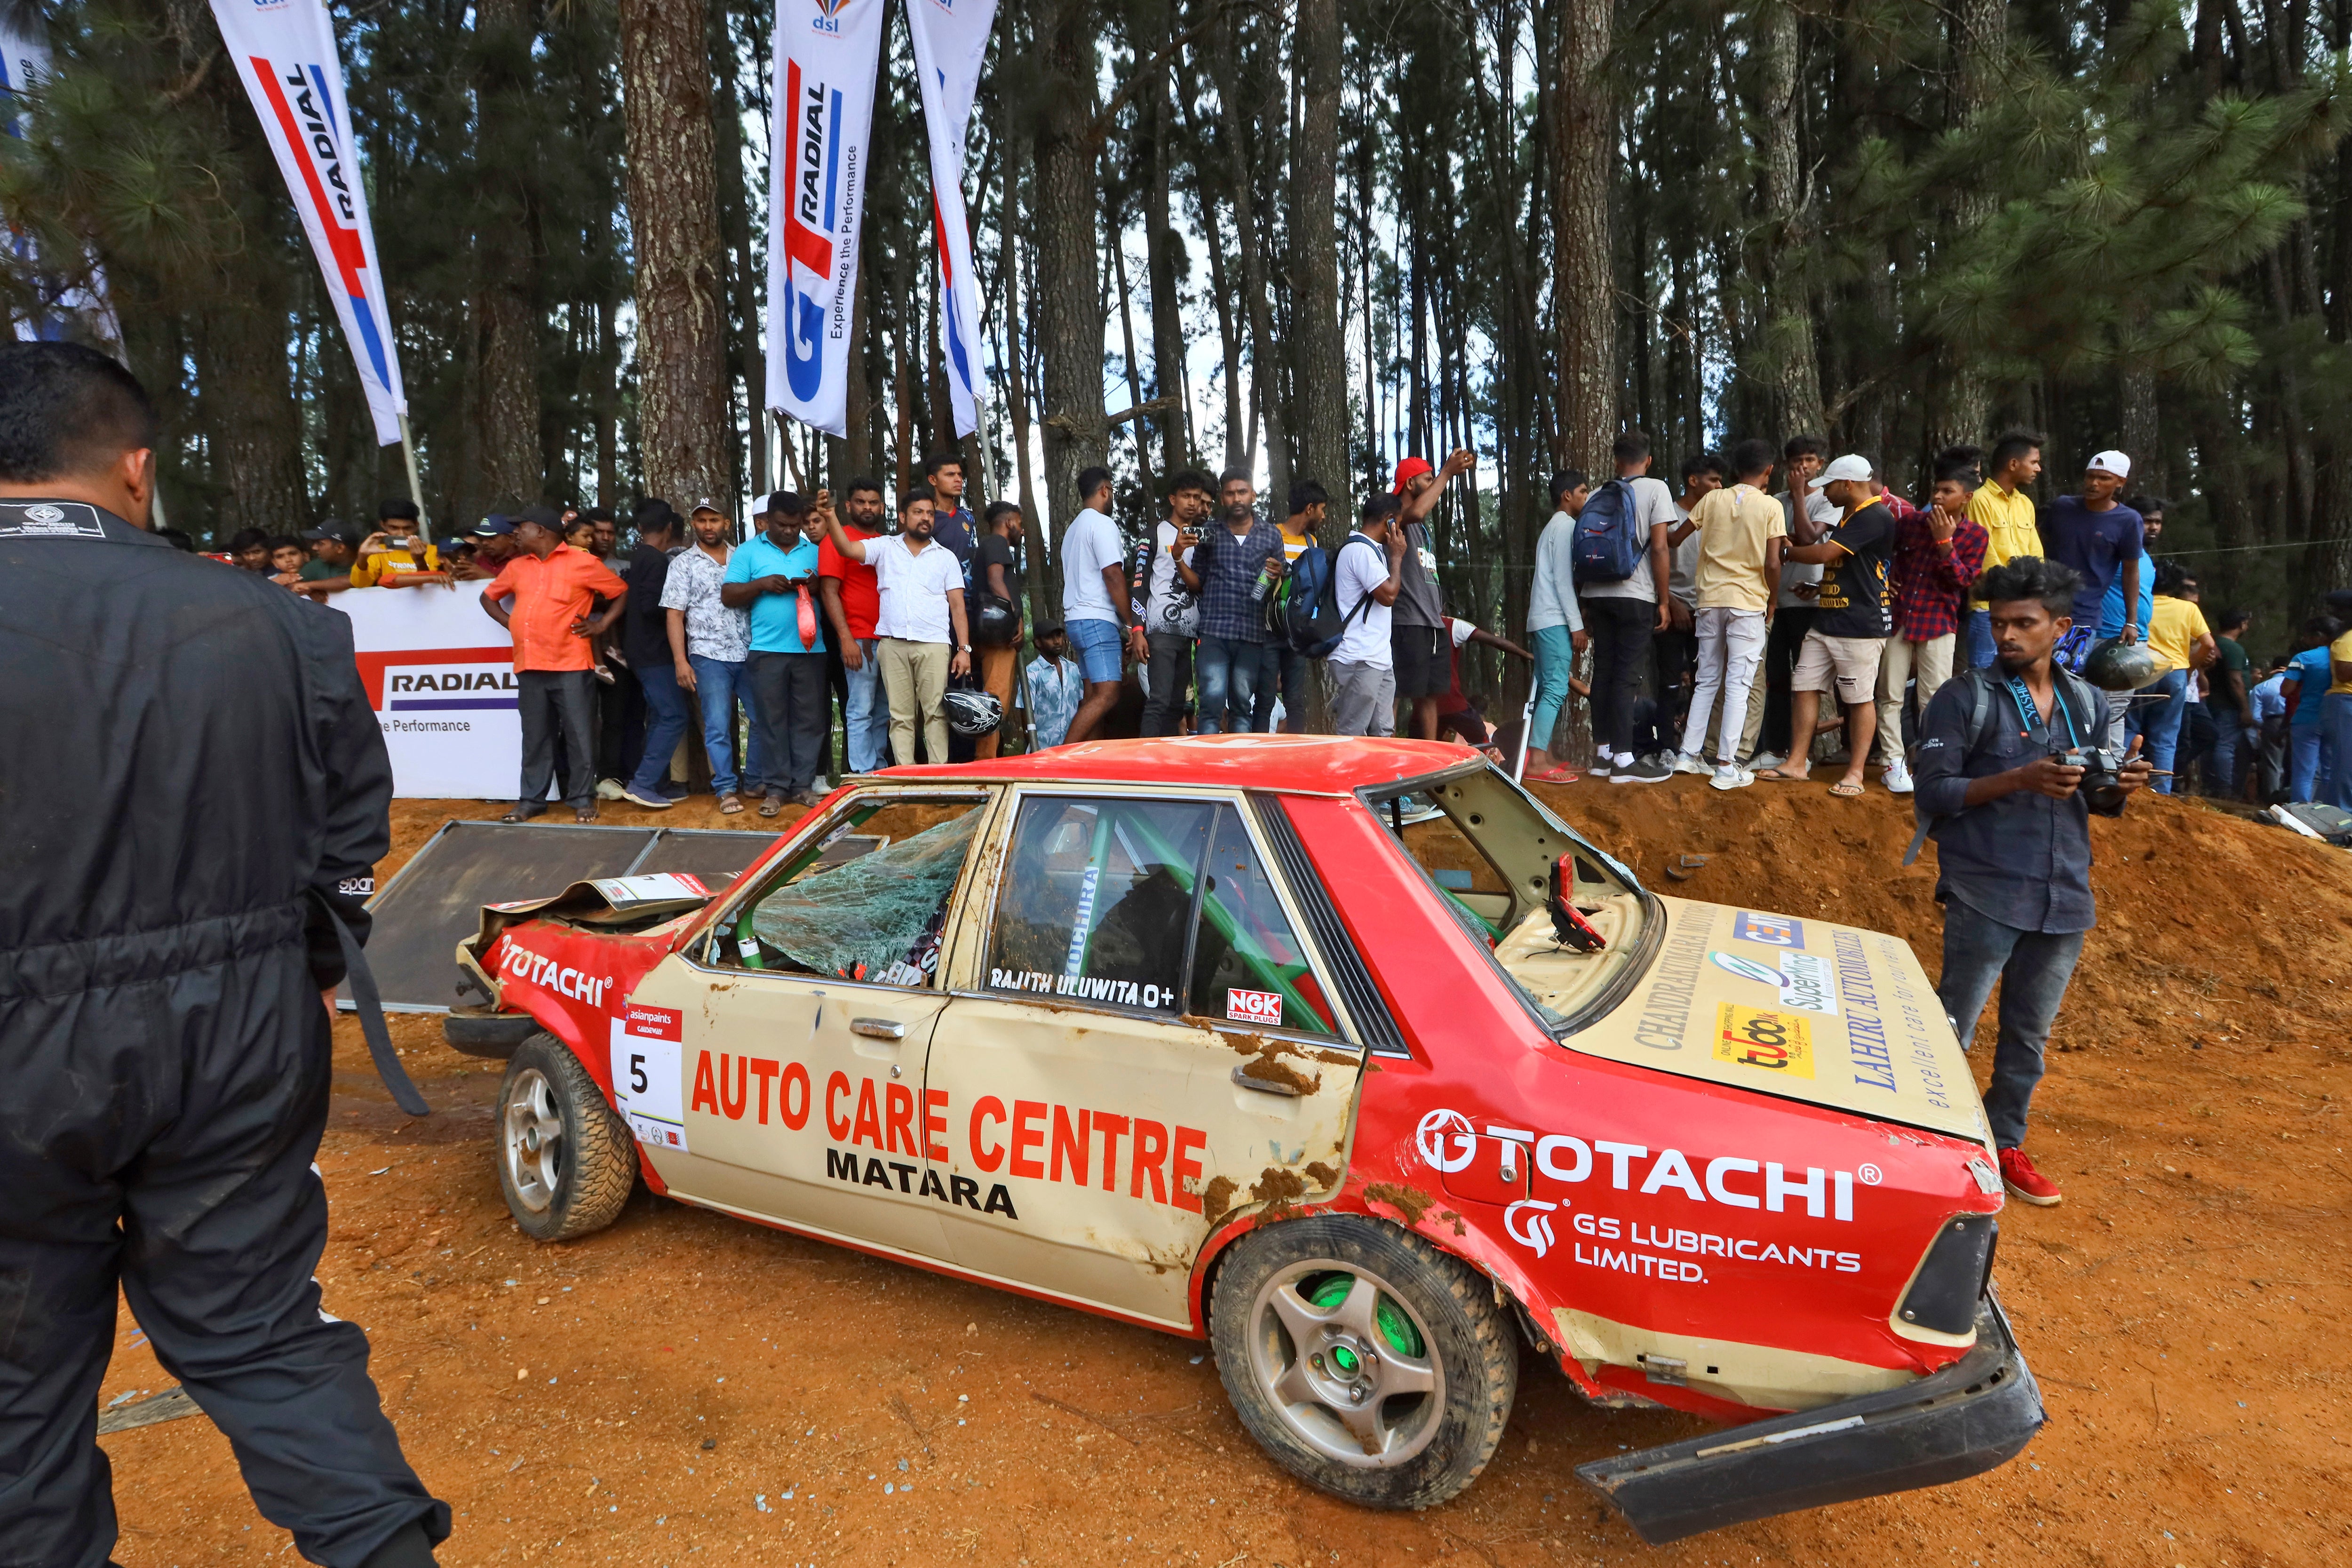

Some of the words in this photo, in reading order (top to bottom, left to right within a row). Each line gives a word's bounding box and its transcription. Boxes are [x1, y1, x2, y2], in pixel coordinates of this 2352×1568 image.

[813, 16, 838, 32] dsl
[286, 64, 355, 219] RADIAL
[802, 82, 825, 224] RADIAL
[841, 145, 857, 236] Performance
[840, 239, 851, 259] the
[831, 263, 850, 339] Experience
[391, 672, 519, 692] RADIAL
[2012, 676, 2037, 718] YASHICA
[393, 720, 470, 732] Performance
[1878, 938, 1899, 963] vehicle
[991, 968, 1053, 993] RAJITH
[1056, 975, 1138, 1006] ULUWITA
[1634, 934, 1709, 1050] CHANDRAKUMARA
[1676, 903, 1718, 934] MOTORS
[1832, 930, 1878, 1011] AUTOMOBILES
[1888, 964, 1907, 984] your
[1229, 992, 1280, 1017] NGK
[1893, 986, 1915, 1002] for
[630, 1010, 671, 1026] asianpaints
[637, 1025, 662, 1035] CAUSEWAY
[1229, 1012, 1252, 1021] SPARK
[1254, 1015, 1279, 1025] PLUGS
[1724, 1013, 1733, 1030] SHOPPING
[1902, 1005, 1925, 1032] care
[1721, 1040, 1731, 1056] ONLINE
[1845, 1008, 1897, 1093] LAHIRU
[631, 1054, 648, 1094] 5
[1907, 1035, 1950, 1108] excellent
[691, 1050, 811, 1131] AUTO
[826, 1071, 949, 1164] CARE
[969, 1095, 1206, 1214] CENTRE
[827, 1147, 1018, 1220] MATARA
[1573, 1213, 1621, 1239] GS
[1631, 1224, 1861, 1273] LUBRICANTS
[1575, 1242, 1709, 1285] LIMITED.
